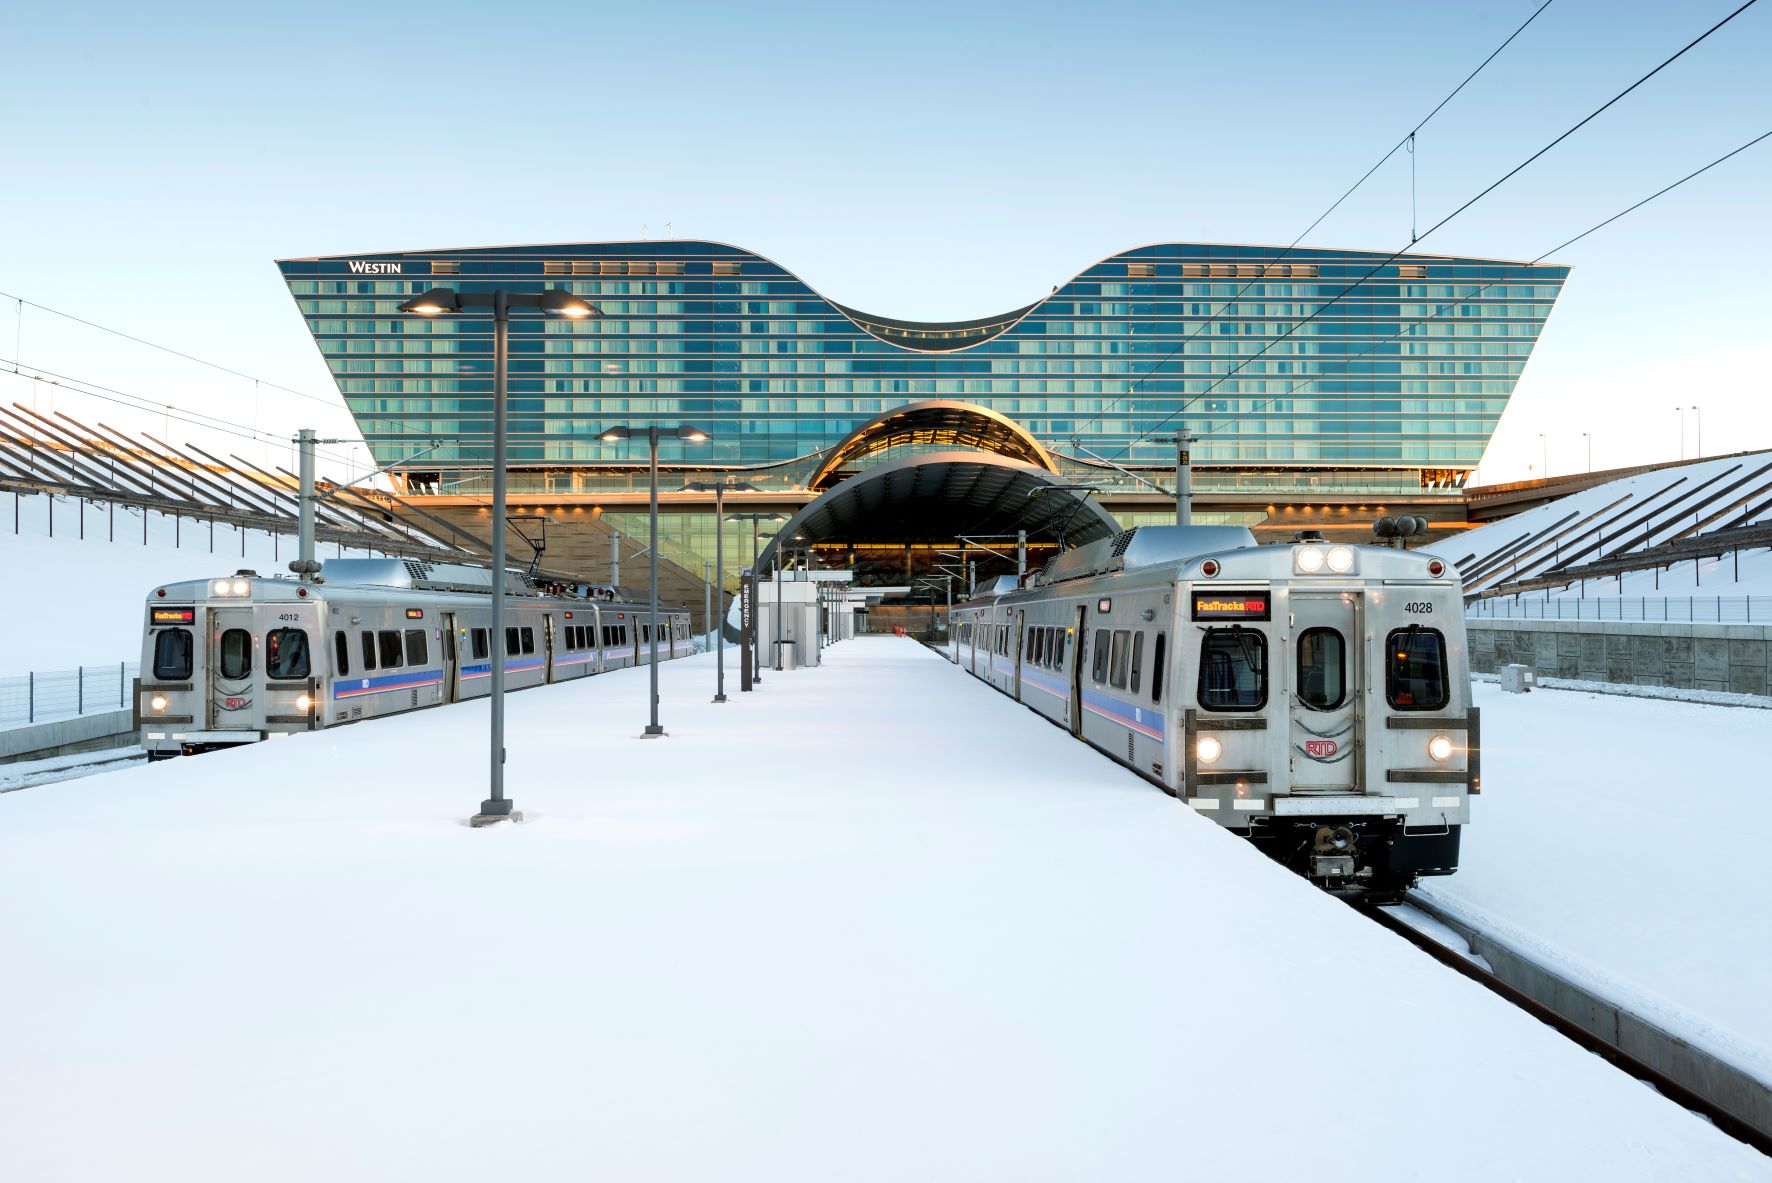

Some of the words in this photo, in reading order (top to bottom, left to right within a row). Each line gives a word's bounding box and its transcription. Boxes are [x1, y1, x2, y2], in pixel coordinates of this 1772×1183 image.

[348, 261, 401, 274] WESTIN
[1197, 601, 1245, 611] FasTracks
[1245, 601, 1265, 612] RTD
[1404, 602, 1433, 614] 4028
[279, 613, 299, 621] 4012
[1306, 740, 1337, 756] RTD
